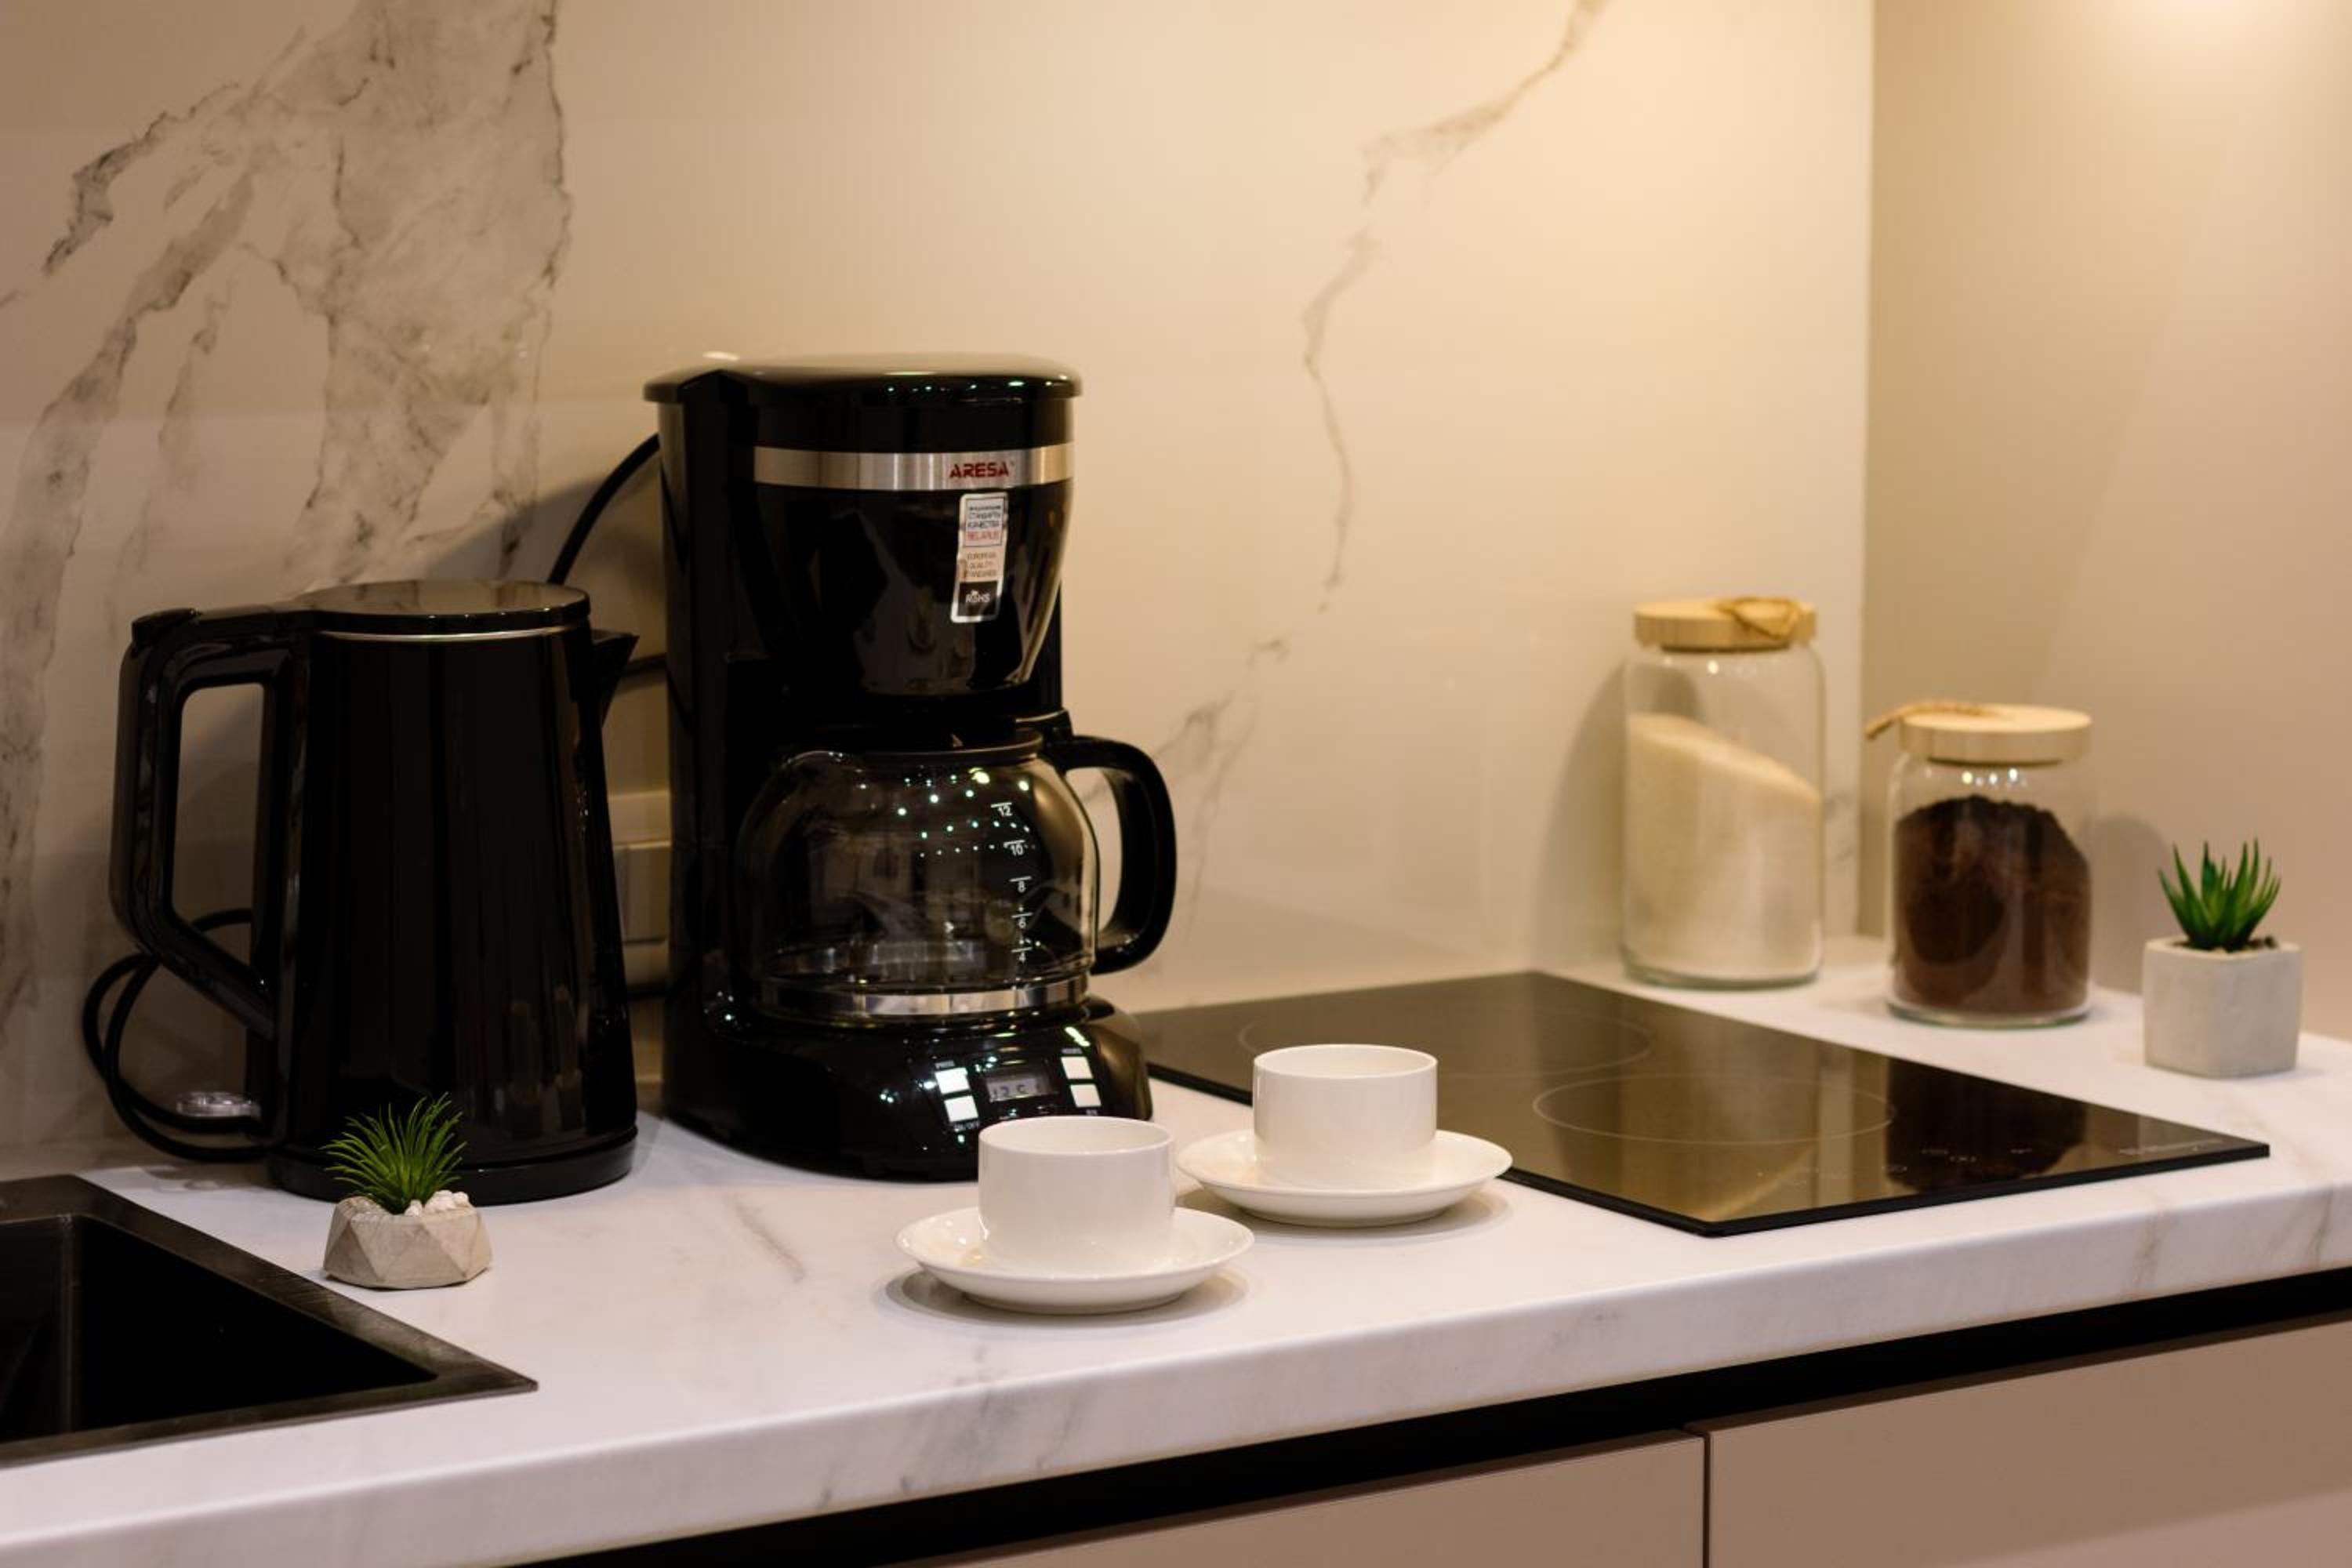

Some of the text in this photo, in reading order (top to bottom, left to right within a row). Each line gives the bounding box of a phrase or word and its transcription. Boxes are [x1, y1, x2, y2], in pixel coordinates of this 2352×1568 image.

[949, 462, 1009, 478] ARESA
[998, 805, 1012, 817] 12
[1011, 844, 1024, 856] 10
[1018, 881, 1025, 893] 8
[1018, 917, 1026, 928] 6
